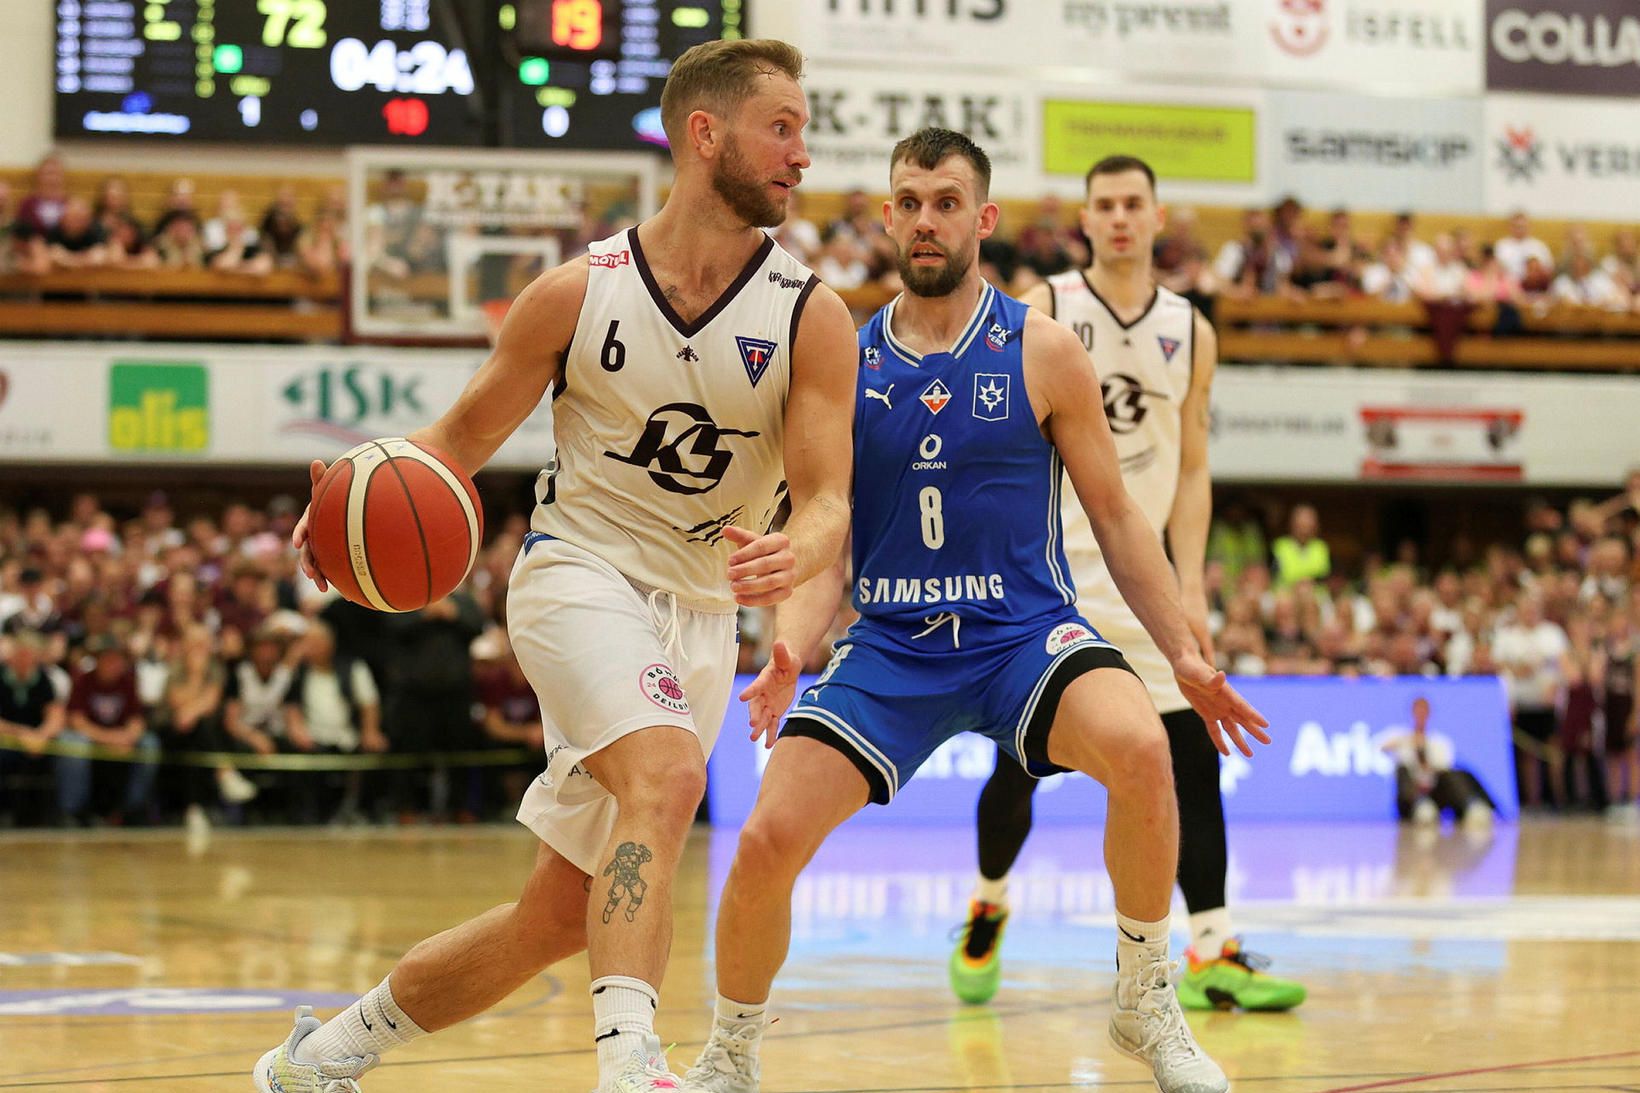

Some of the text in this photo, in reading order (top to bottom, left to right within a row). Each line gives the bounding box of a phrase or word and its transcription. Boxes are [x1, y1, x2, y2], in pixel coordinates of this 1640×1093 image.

[330, 38, 474, 95] 04:24
[590, 251, 629, 268] MOTUL
[600, 319, 626, 373] 6
[990, 323, 1011, 342] PK
[912, 461, 947, 471] ORKAN
[919, 486, 945, 550] 8
[859, 574, 1005, 604] SAMSUNG
